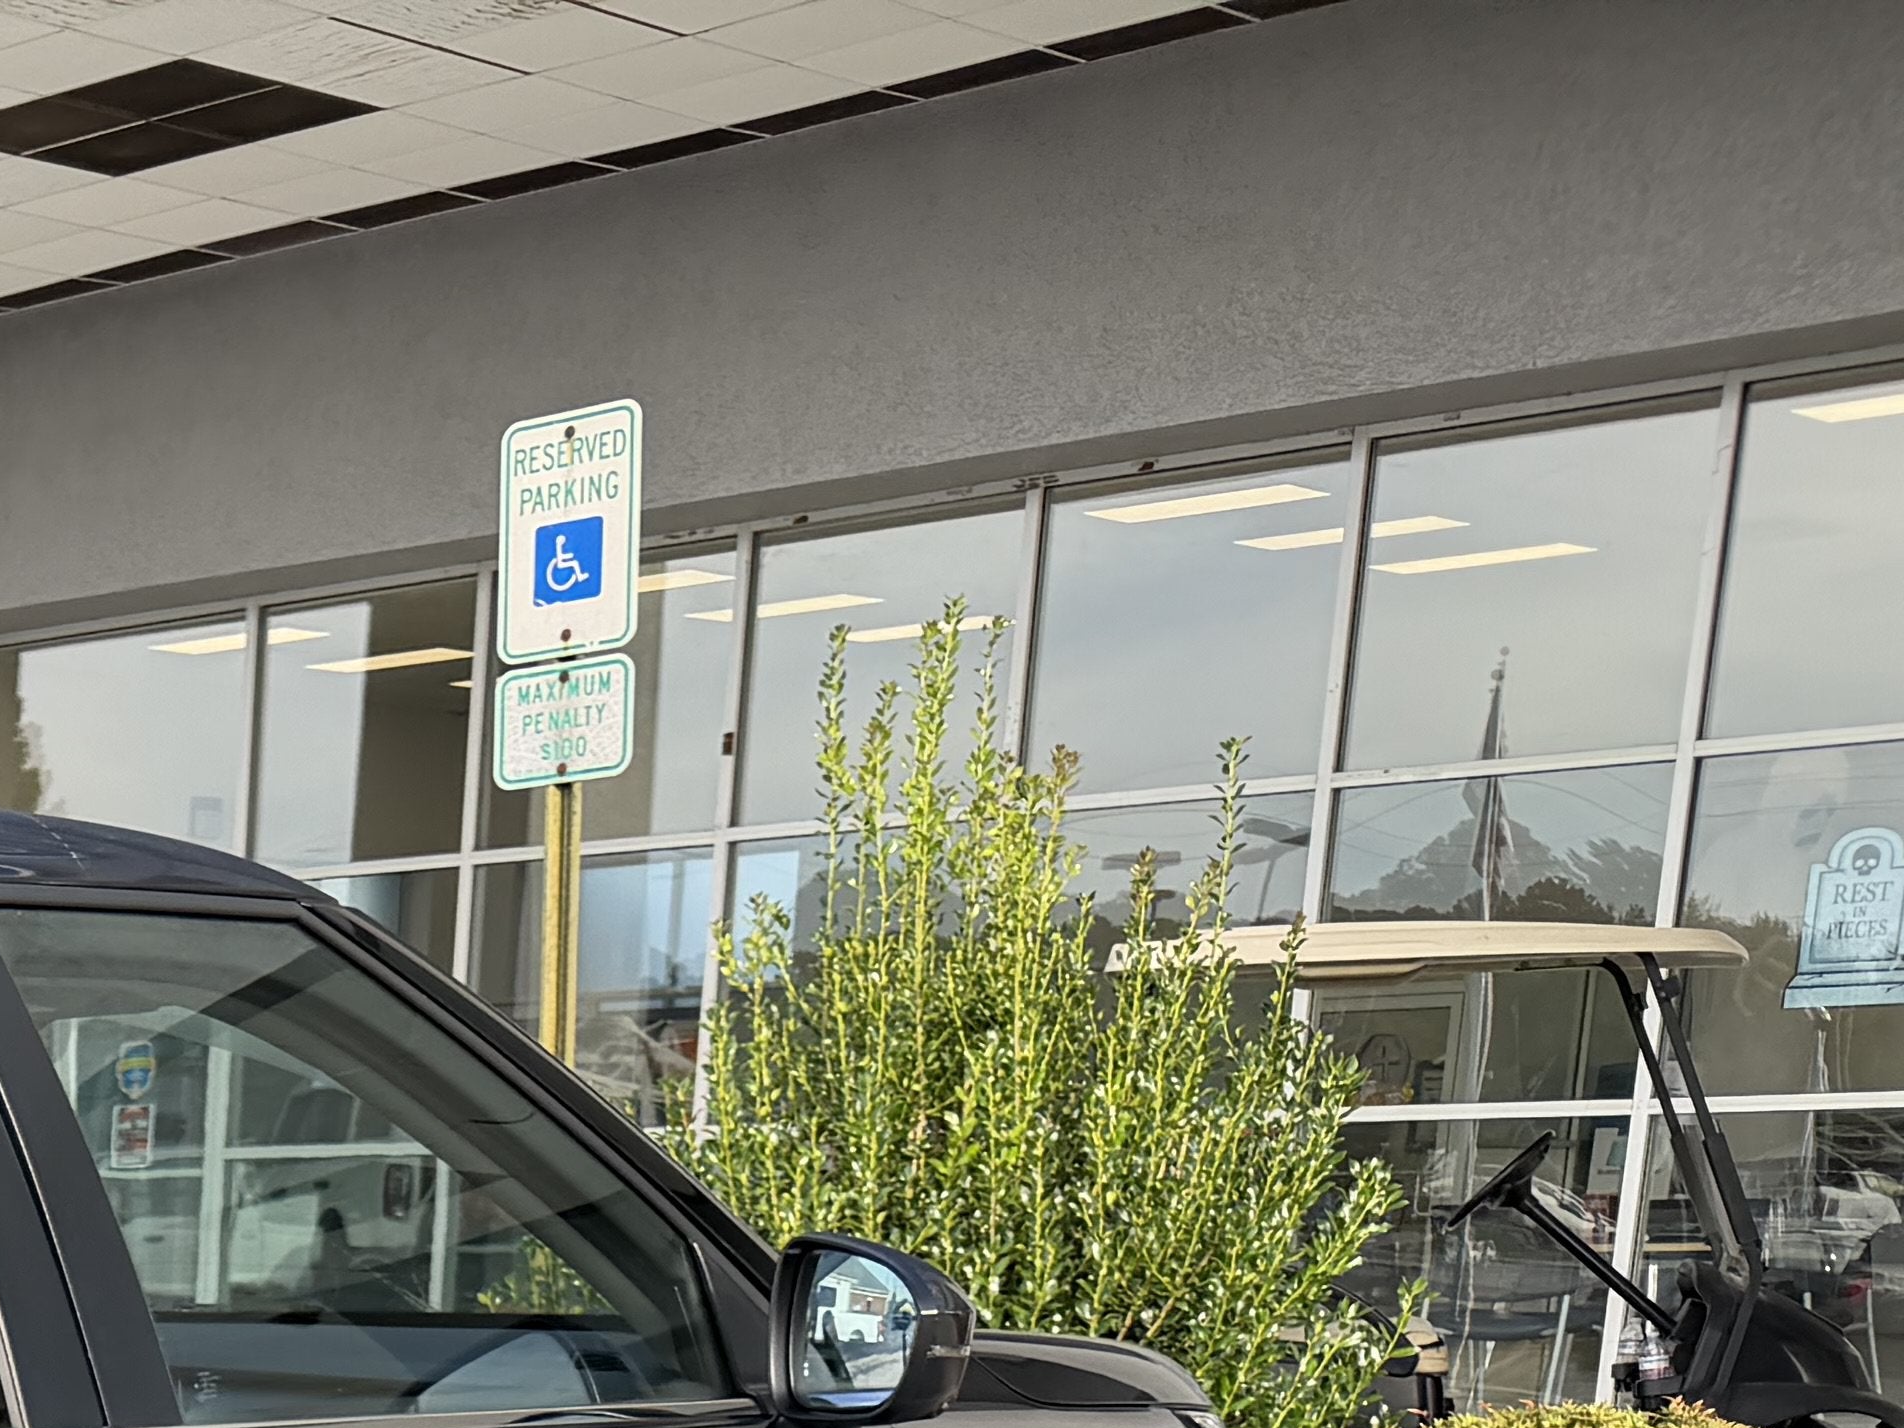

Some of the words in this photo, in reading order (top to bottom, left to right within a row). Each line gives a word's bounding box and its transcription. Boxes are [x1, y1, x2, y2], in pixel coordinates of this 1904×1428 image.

[513, 428, 627, 477] RESERVED
[519, 470, 619, 517] PARKING
[517, 670, 612, 707] MAXIMUM
[521, 702, 606, 737] PENALTY
[1832, 880, 1895, 905] REST
[1825, 918, 1889, 940] PIECES
[1852, 905, 1868, 918] IN
